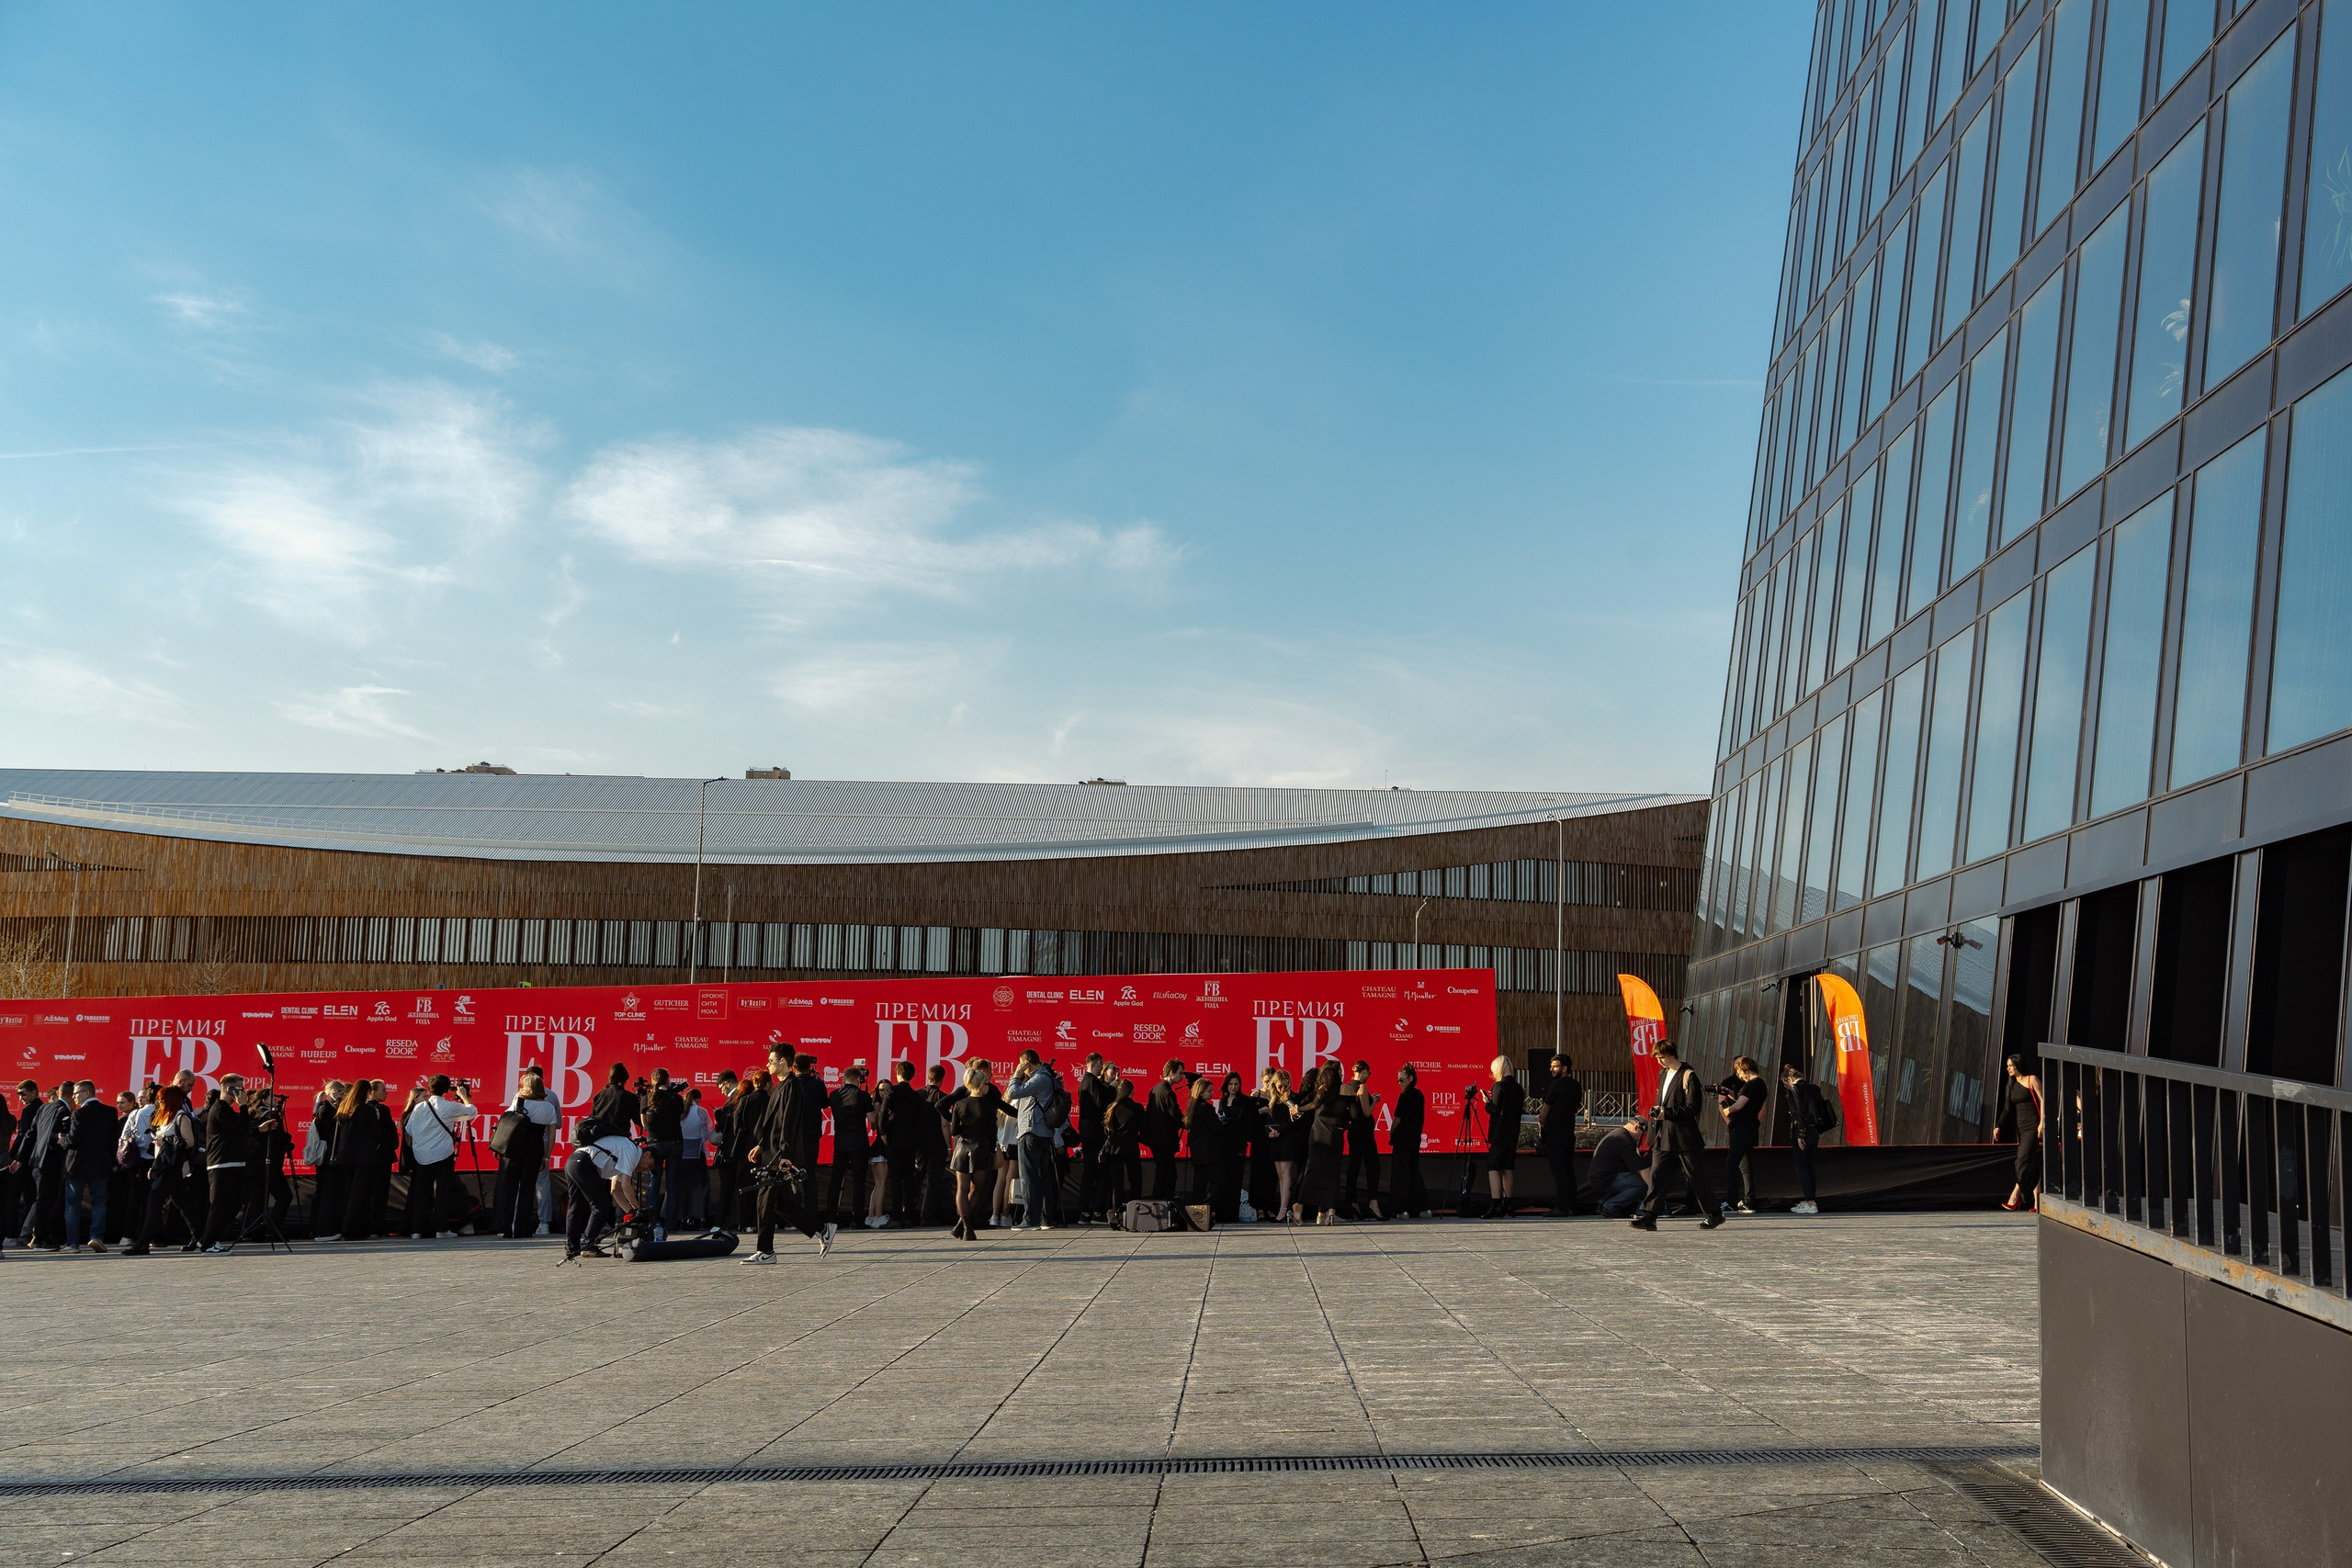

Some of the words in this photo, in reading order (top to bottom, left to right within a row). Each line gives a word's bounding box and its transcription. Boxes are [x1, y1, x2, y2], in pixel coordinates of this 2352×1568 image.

[1069, 989, 1103, 1000] ELEN
[1204, 983, 1220, 997] FB
[1447, 986, 1479, 995] Choupette
[1153, 991, 1187, 1000] ElishaCoy
[323, 1005, 357, 1016] ELEN
[416, 999, 432, 1012] FB
[1253, 999, 1345, 1017] ПРЕМИЯ
[876, 1002, 972, 1021] ПРЕМИЯ
[130, 1019, 227, 1035] ПРЕМИЯ
[505, 1015, 596, 1032] ПРЕМИЯ
[1134, 1023, 1166, 1032] RESEDA
[1092, 1030, 1124, 1039] Choupette
[386, 1039, 418, 1047] RESEDA
[1179, 1036, 1204, 1045] SELFIE
[300, 1050, 337, 1058] RUBEUS
[345, 1044, 376, 1054] Choupette
[430, 1051, 455, 1061] SELFIE
[1195, 1063, 1231, 1074] ELEN
[695, 1072, 719, 1082] ELE
[1432, 1092, 1460, 1104] PIPL
